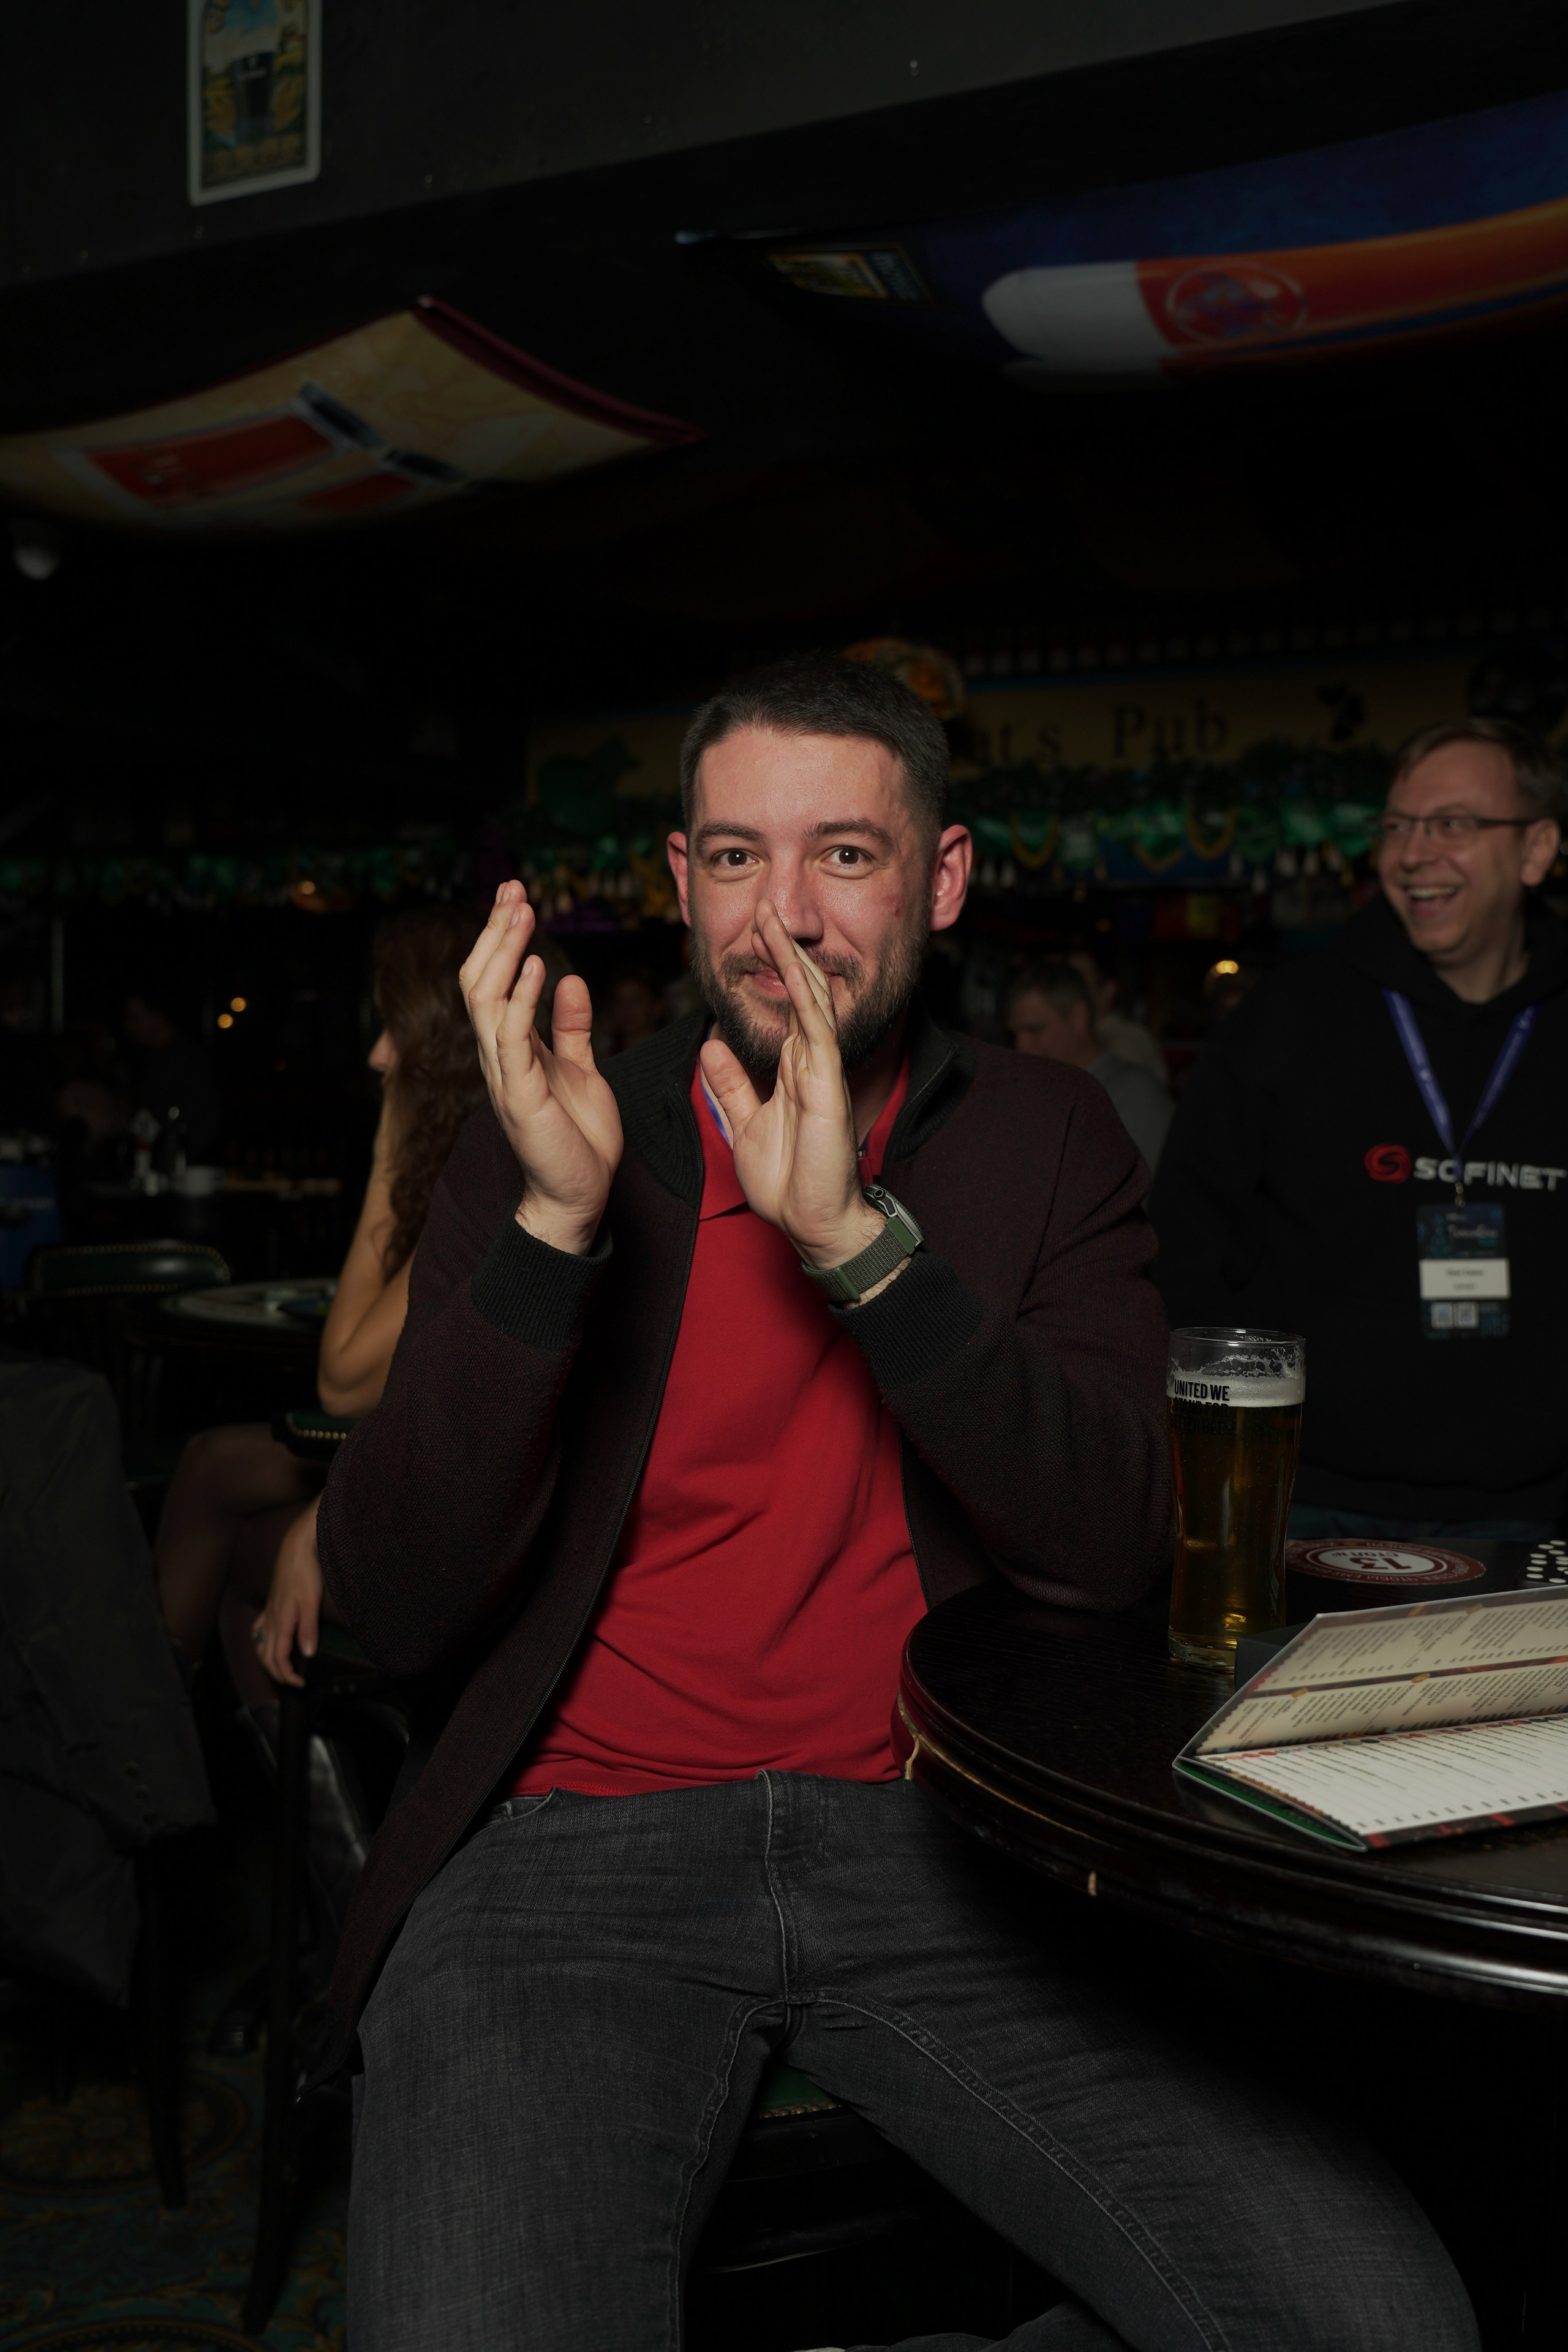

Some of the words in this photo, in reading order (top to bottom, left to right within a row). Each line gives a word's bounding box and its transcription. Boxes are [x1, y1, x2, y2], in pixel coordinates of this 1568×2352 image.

[1112, 695, 1229, 759] Pub
[1413, 1156, 1567, 1192] SOFINET
[1174, 1379, 1207, 1399] UNITED
[1210, 1384, 1229, 1401] WE
[1174, 1397, 1202, 1415] STAND
[1205, 1402, 1229, 1419] FOR
[1350, 1557, 1412, 1570] 13
